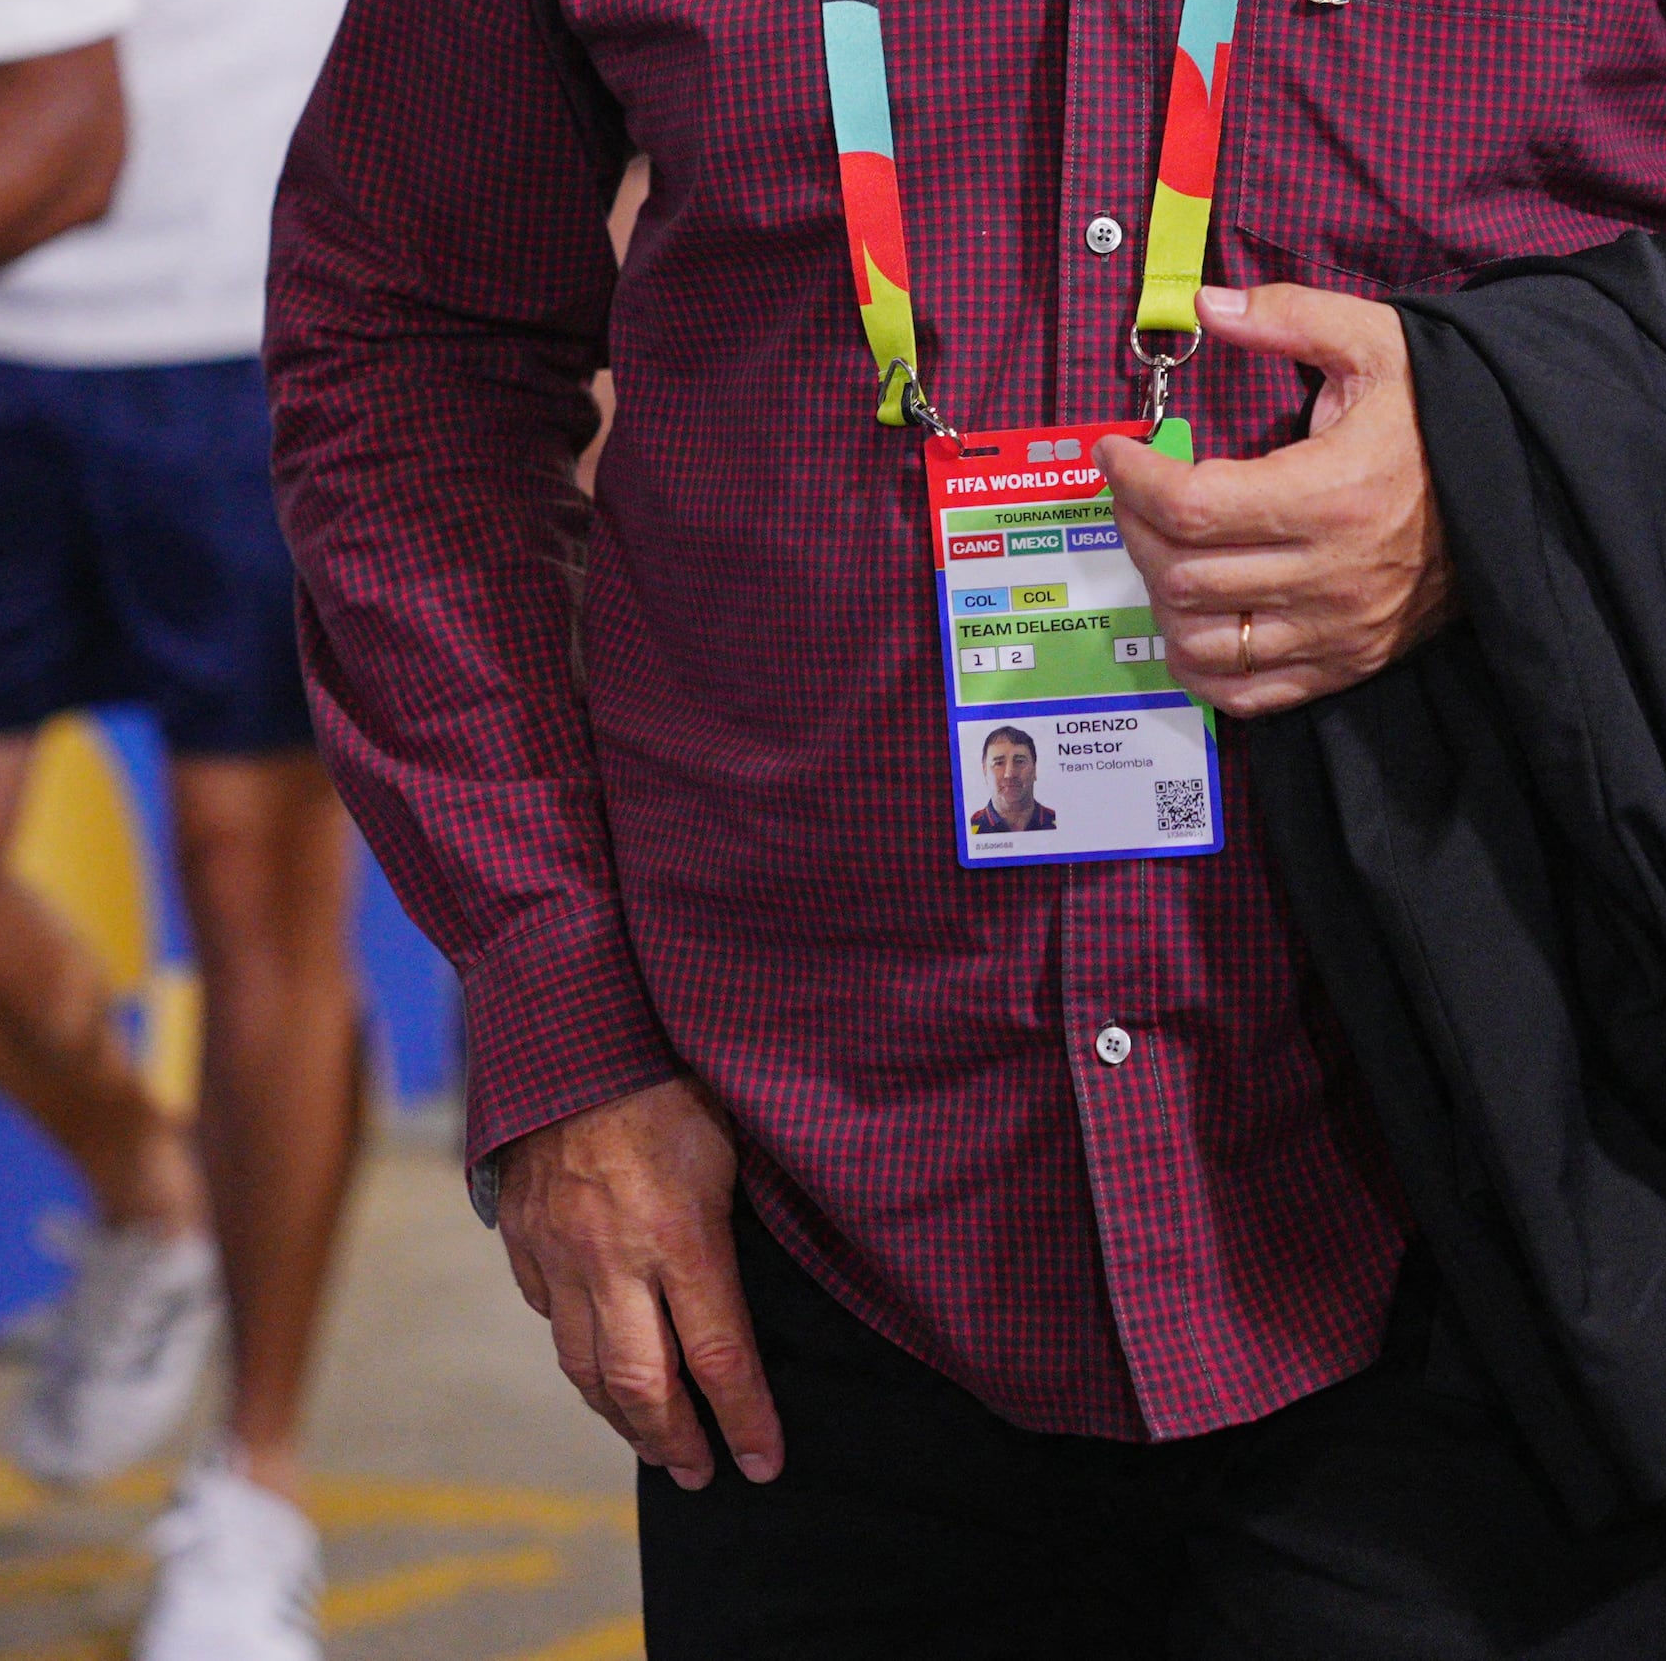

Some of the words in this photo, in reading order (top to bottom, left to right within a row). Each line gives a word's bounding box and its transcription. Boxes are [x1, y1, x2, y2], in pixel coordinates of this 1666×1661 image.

[945, 476, 989, 495] FIFA
[988, 470, 1060, 491] WORLD
[1061, 467, 1101, 486] CUP
[995, 507, 1091, 525] TOURNAMENT
[1094, 506, 1114, 518] PA
[1010, 534, 1060, 551] MEXC
[1071, 530, 1119, 547] USAC
[952, 539, 1001, 555] CANC
[964, 594, 998, 608] COL
[1023, 590, 1056, 604] COL
[959, 622, 1012, 638] TEAM
[1016, 615, 1111, 635] DELEGATE
[1126, 643, 1138, 656] 5
[973, 654, 983, 666] 1
[1010, 651, 1022, 664] 2
[1056, 717, 1138, 734] LORENZO
[1058, 741, 1123, 756] Nestor
[1059, 762, 1093, 773] Team
[1096, 758, 1154, 771] Colombia
